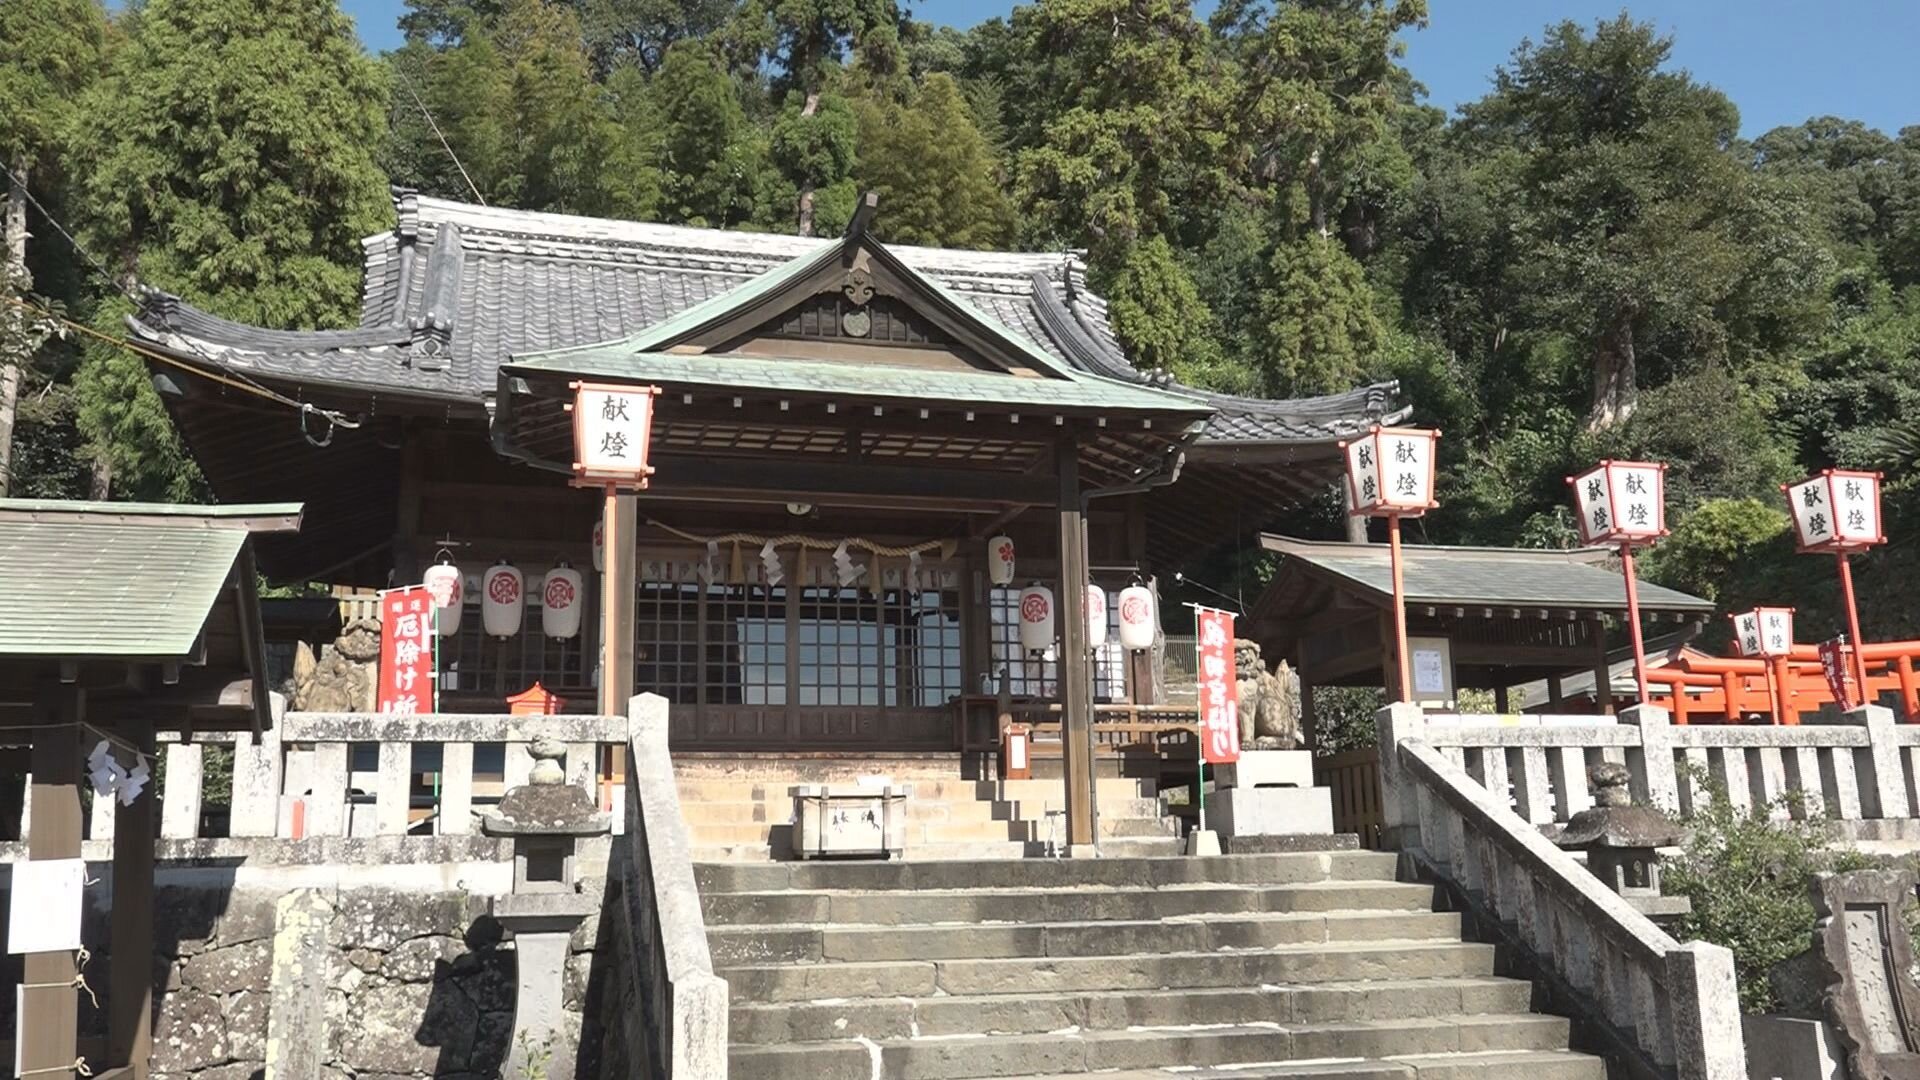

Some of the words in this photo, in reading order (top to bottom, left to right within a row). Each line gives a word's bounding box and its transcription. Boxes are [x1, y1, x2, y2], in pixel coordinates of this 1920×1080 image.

[600, 394, 630, 459] 献燈
[1358, 445, 1376, 501] 献燈
[1395, 440, 1418, 496] 献燈
[1587, 478, 1609, 531] 献燈
[1625, 472, 1648, 525] 献燈
[1803, 485, 1828, 536] 献燈
[1845, 479, 1865, 530] 献燈
